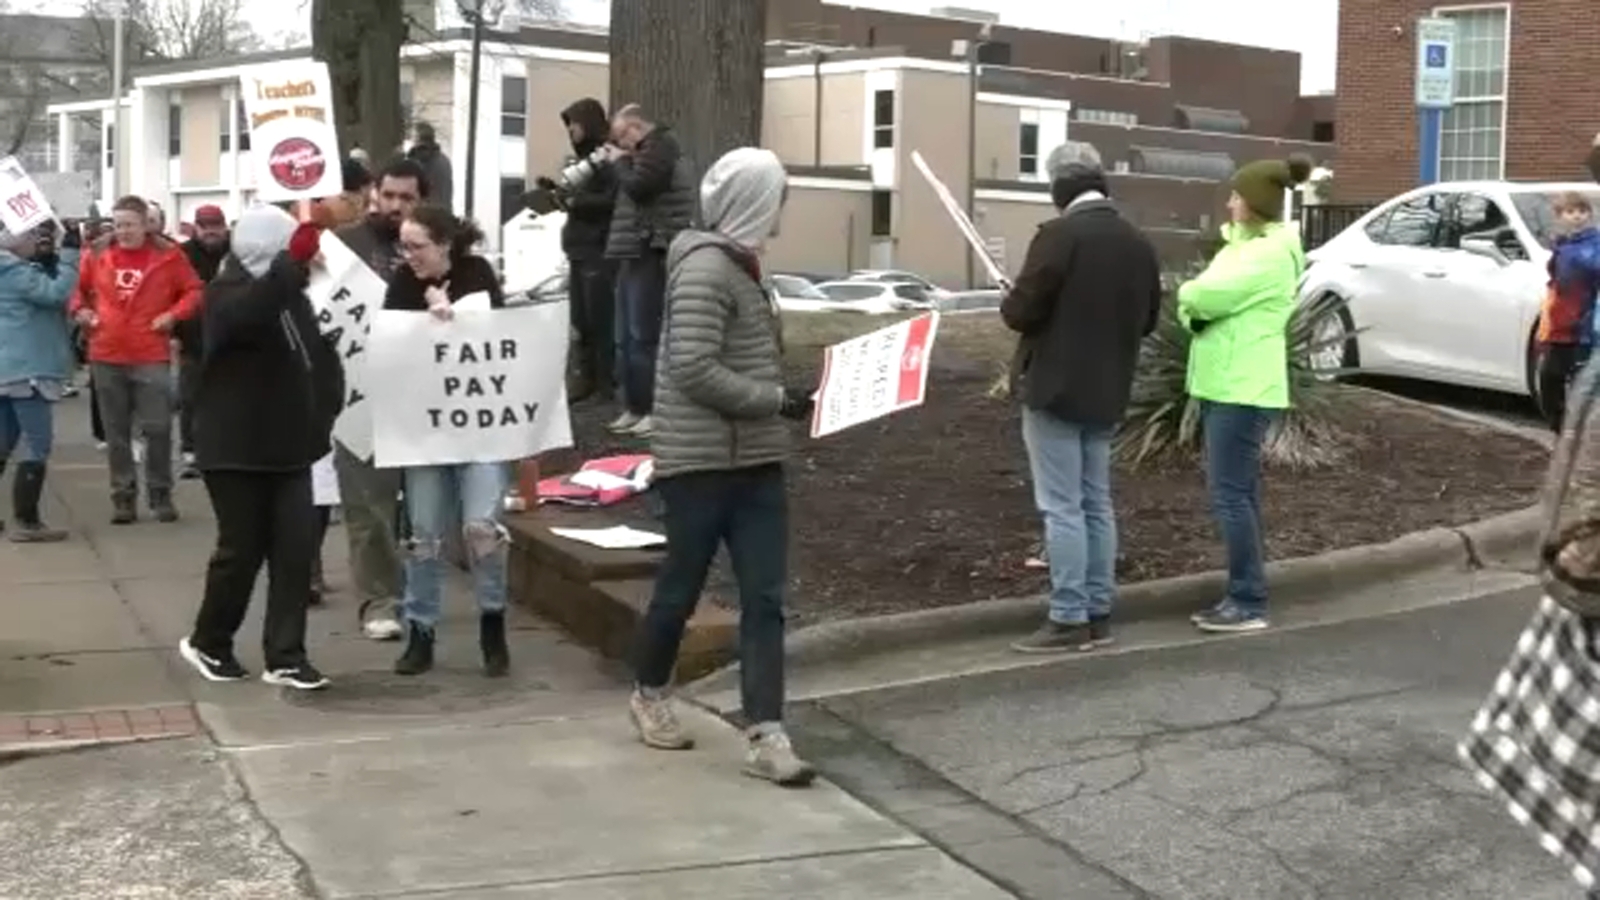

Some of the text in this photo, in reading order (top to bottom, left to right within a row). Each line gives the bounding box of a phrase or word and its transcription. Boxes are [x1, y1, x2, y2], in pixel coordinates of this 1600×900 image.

[434, 339, 517, 363] FAIR
[444, 374, 506, 397] PAY
[427, 402, 539, 428] TODAY
